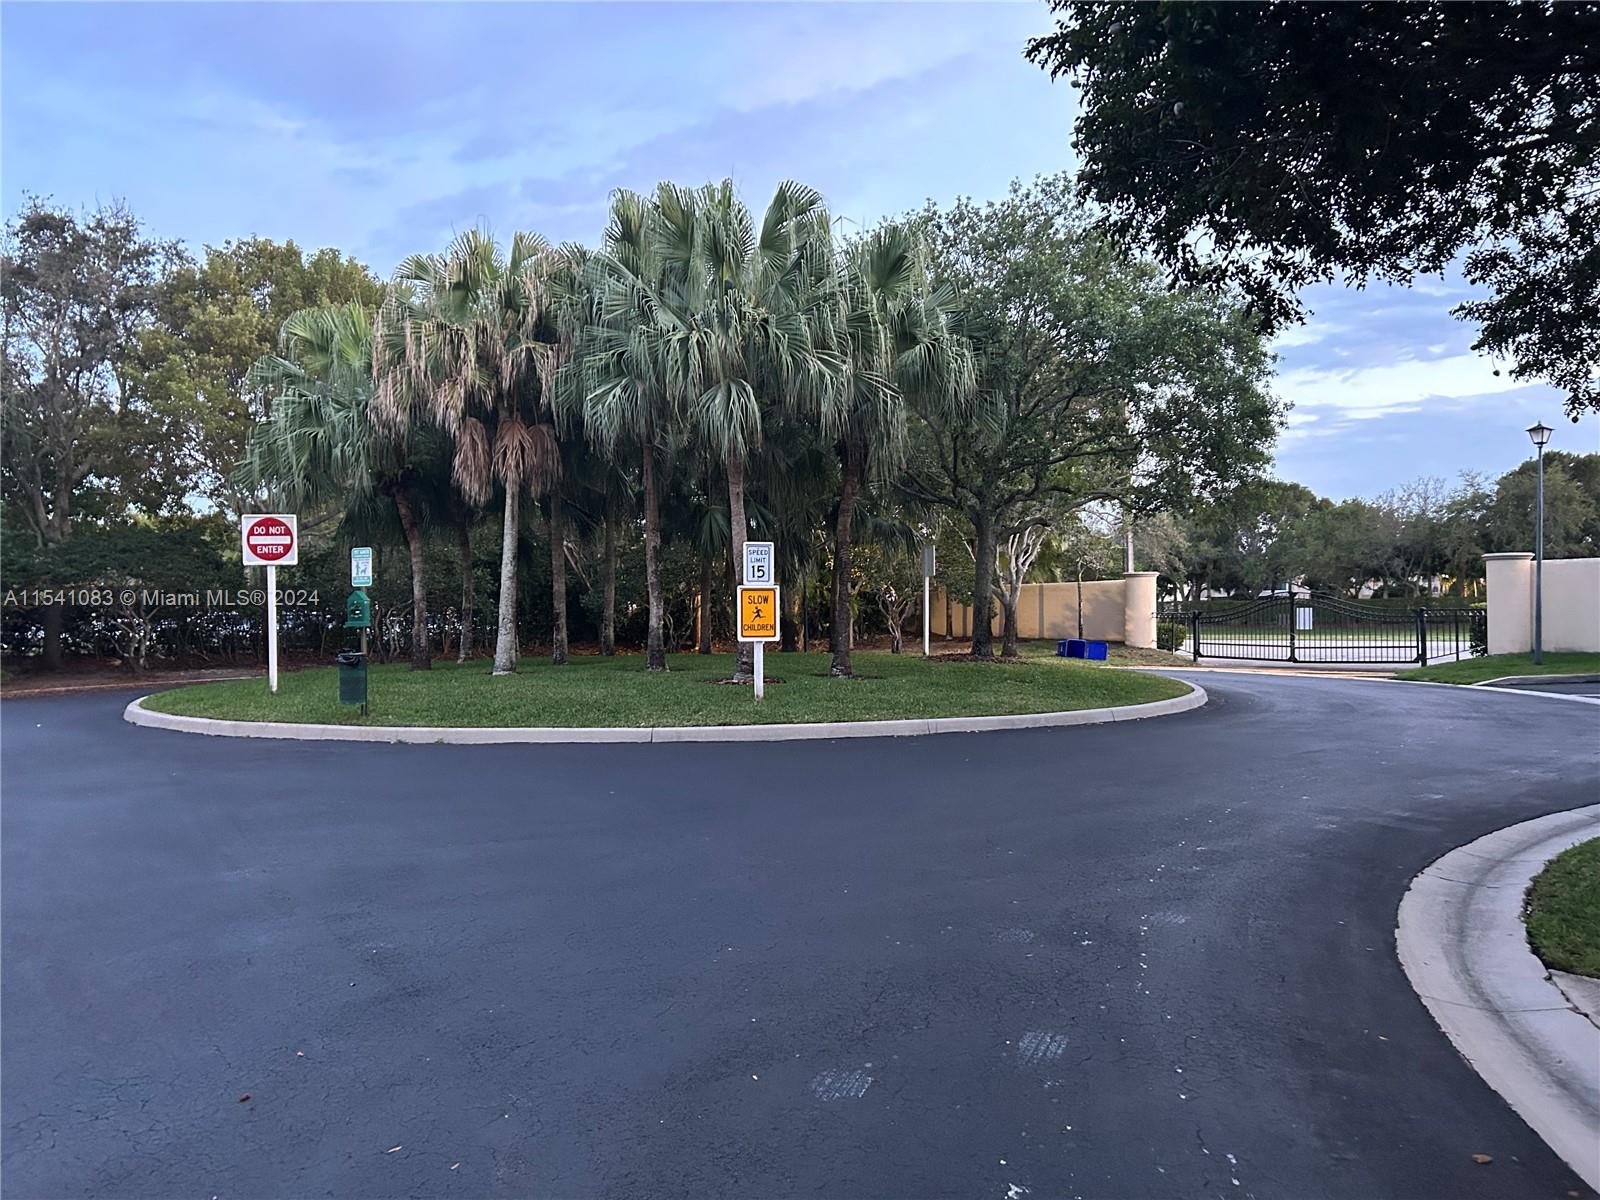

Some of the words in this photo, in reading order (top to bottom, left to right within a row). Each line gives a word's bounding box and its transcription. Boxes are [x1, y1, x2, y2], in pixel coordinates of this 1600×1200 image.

[254, 526, 265, 534] DO
[269, 526, 285, 534] NOT
[751, 565, 765, 578] 15
[748, 595, 768, 604] SLOW
